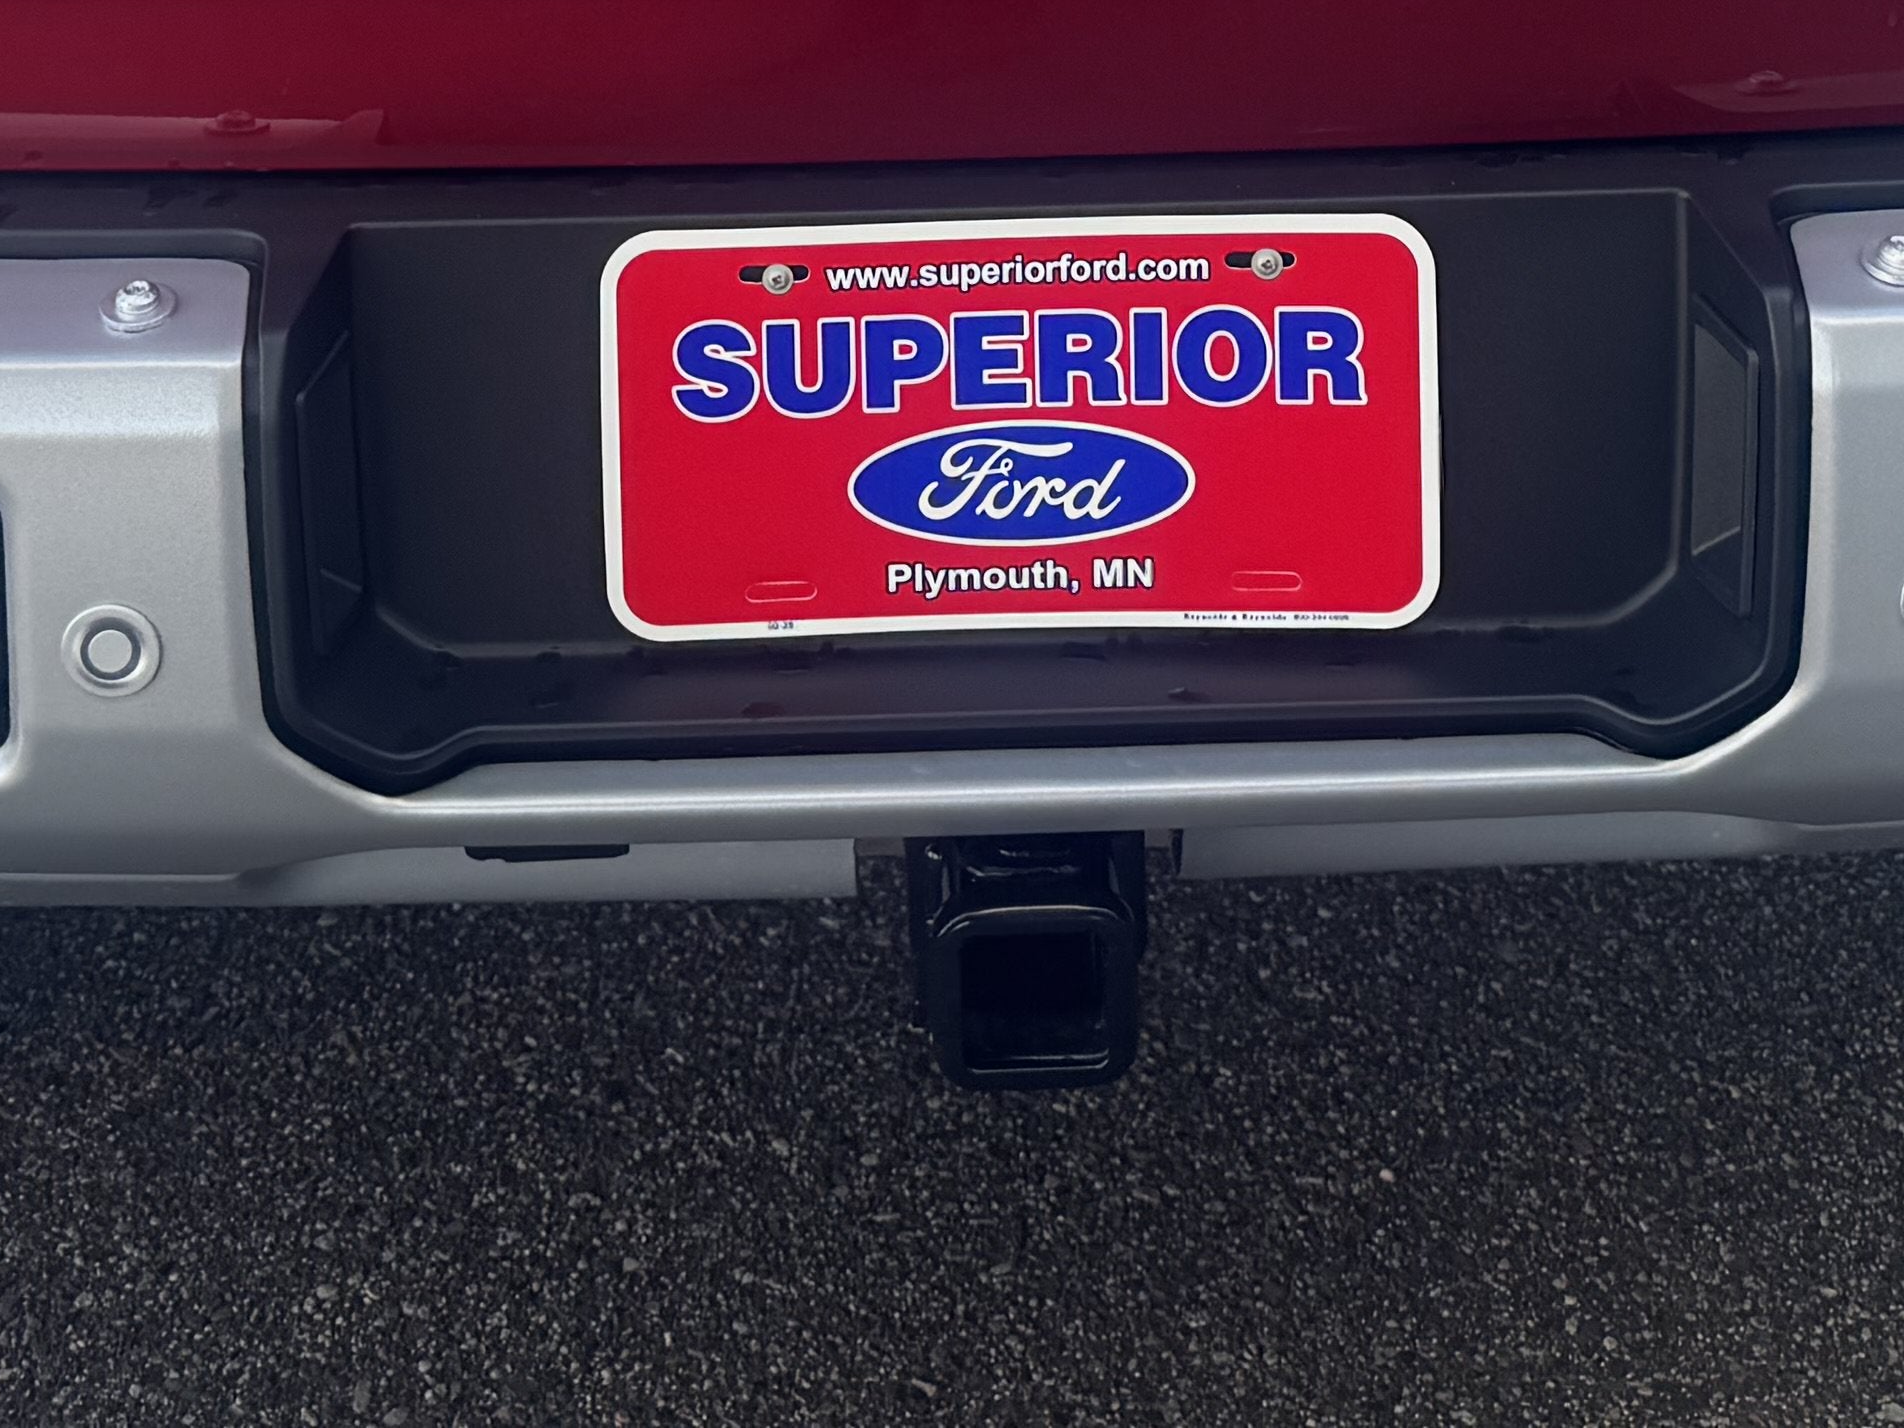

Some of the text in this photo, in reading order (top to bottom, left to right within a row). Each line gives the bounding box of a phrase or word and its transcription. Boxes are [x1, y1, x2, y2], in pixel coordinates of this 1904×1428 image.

[827, 253, 1210, 292] www.superiorford.com
[671, 304, 1368, 422] SUPERIOR
[919, 437, 1126, 520] Ford
[887, 557, 1155, 597] Plymouth, MN
